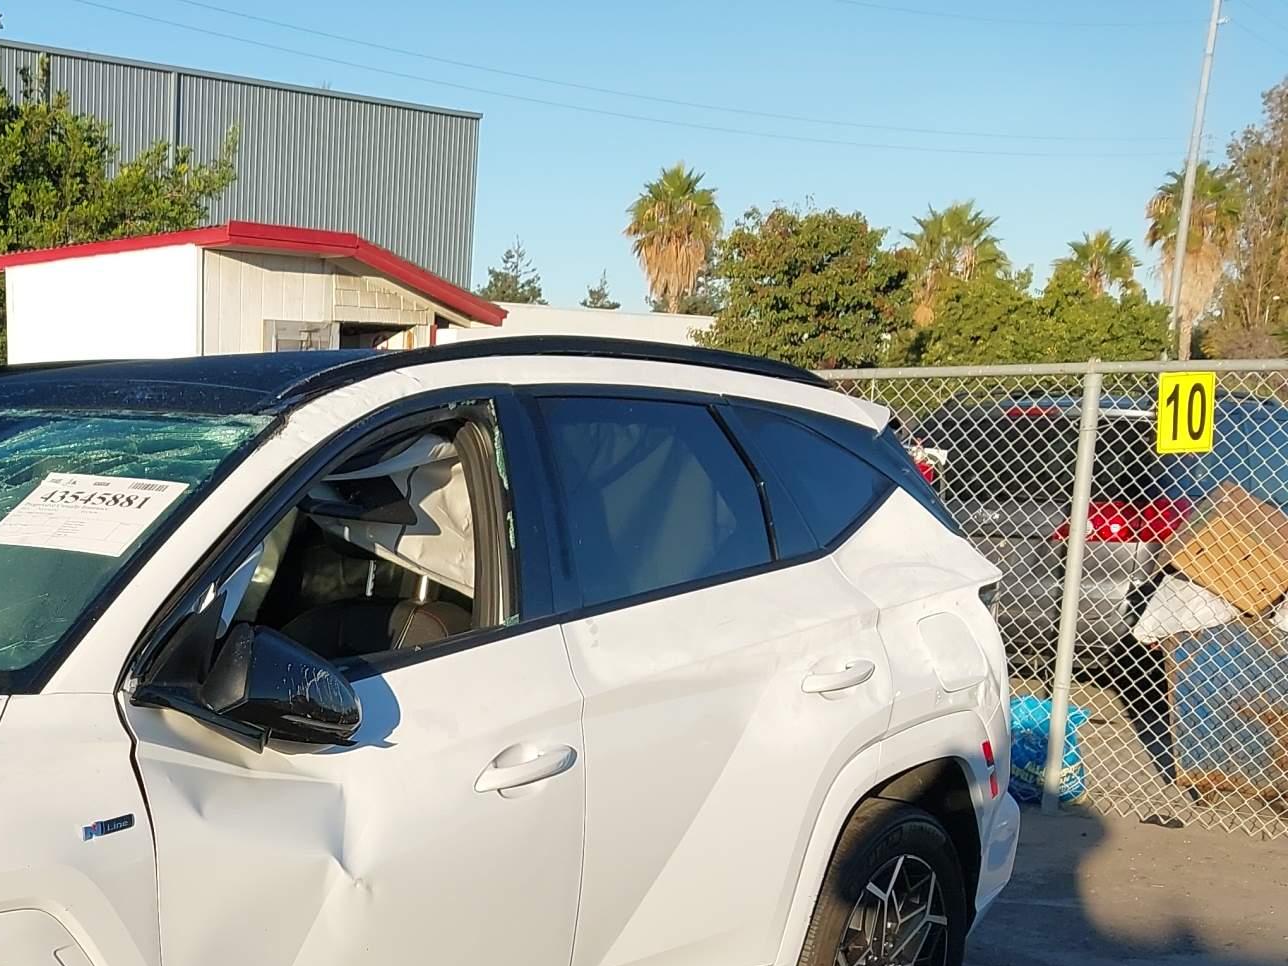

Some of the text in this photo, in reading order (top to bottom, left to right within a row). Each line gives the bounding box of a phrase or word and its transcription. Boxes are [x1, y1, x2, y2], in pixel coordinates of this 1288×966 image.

[1166, 382, 1206, 441] 10
[40, 490, 151, 509] 43545881
[106, 820, 129, 832] Line
